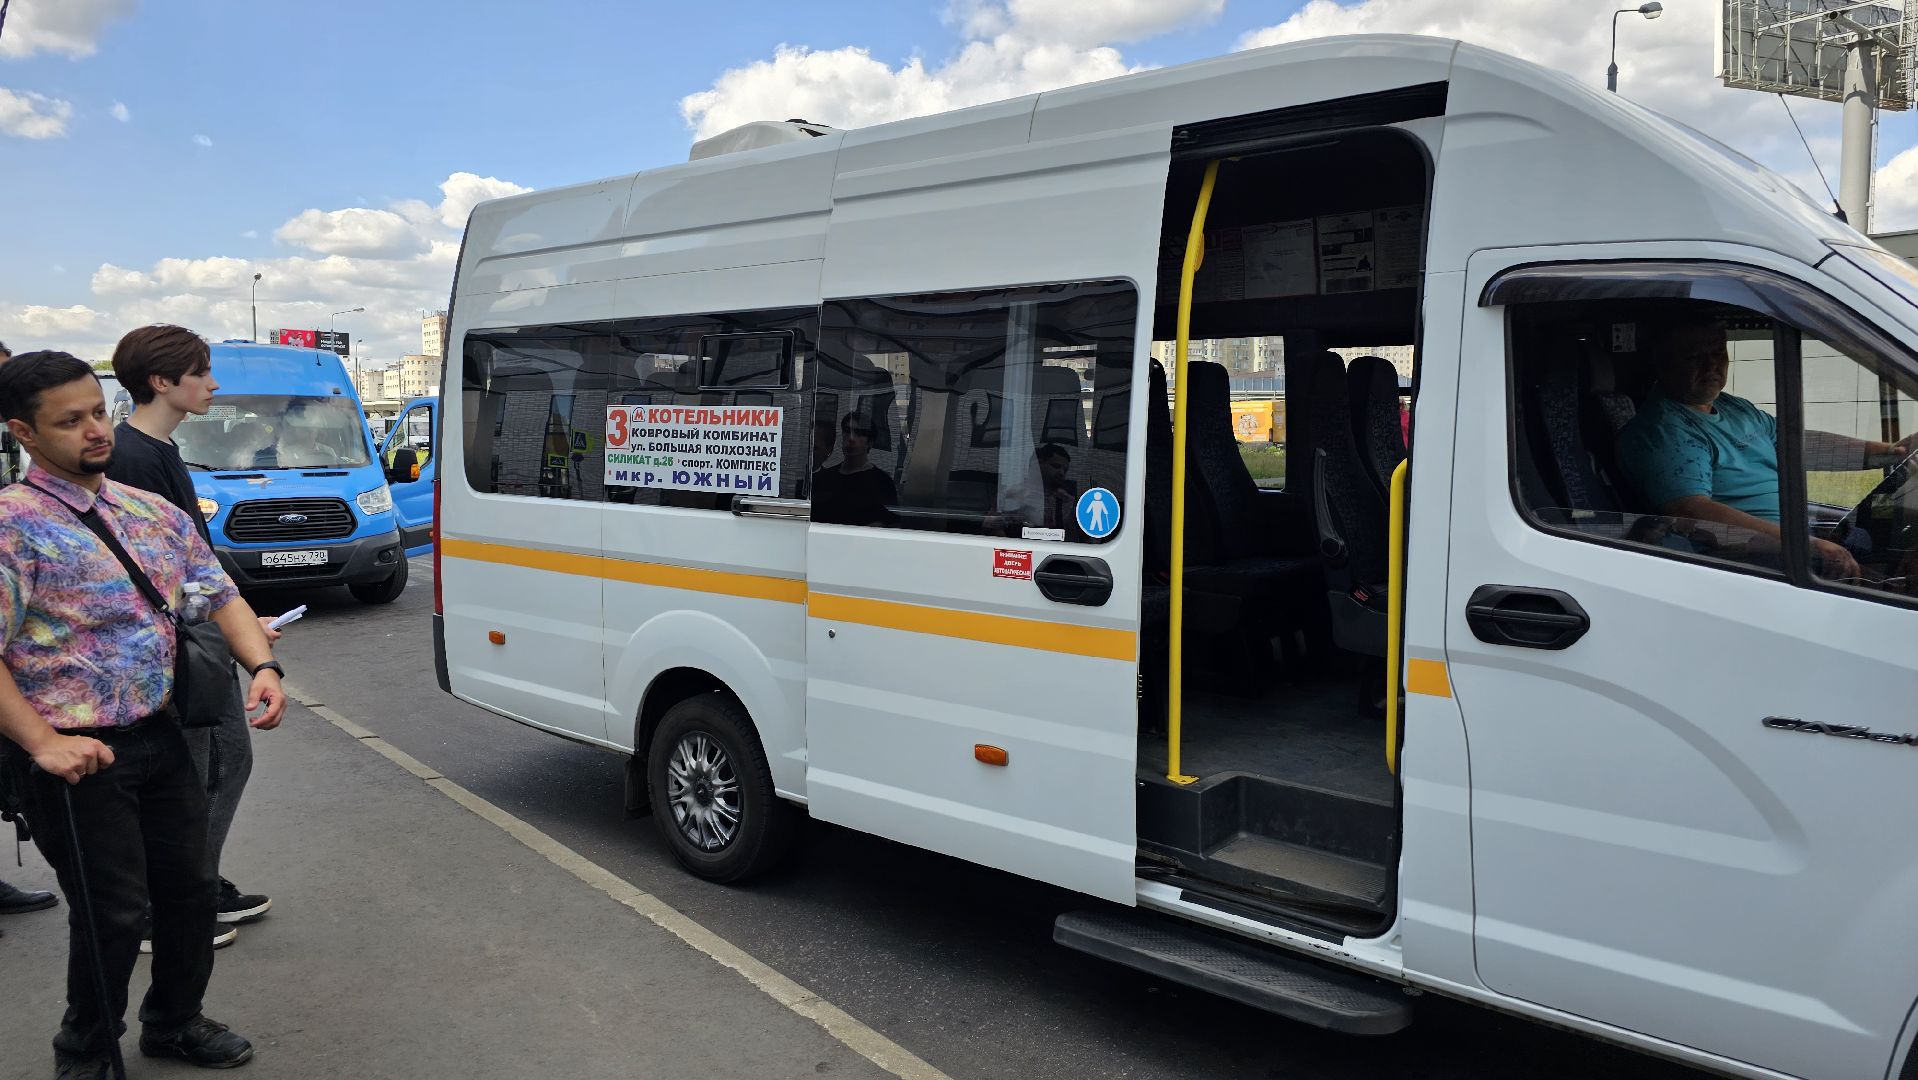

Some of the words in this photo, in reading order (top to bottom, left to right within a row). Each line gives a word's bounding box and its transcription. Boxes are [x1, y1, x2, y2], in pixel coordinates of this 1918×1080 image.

[648, 409, 779, 426] КОТЕЛЬНИКИ
[608, 409, 628, 446] 3
[631, 428, 700, 439] КОВРОВЫЙ
[703, 430, 777, 443] КОМБИНАТ
[631, 444, 646, 453] ул.
[649, 442, 702, 454] БОЛЬШАЯ
[705, 445, 777, 457] КОЛХОЗНАЯ
[608, 454, 651, 465] СИЛИКАТ
[681, 459, 713, 469] спорт.
[716, 458, 777, 472] КОМПЛЕКС
[615, 470, 663, 486] мкр.
[672, 470, 772, 491] ЮЖНЫЙ
